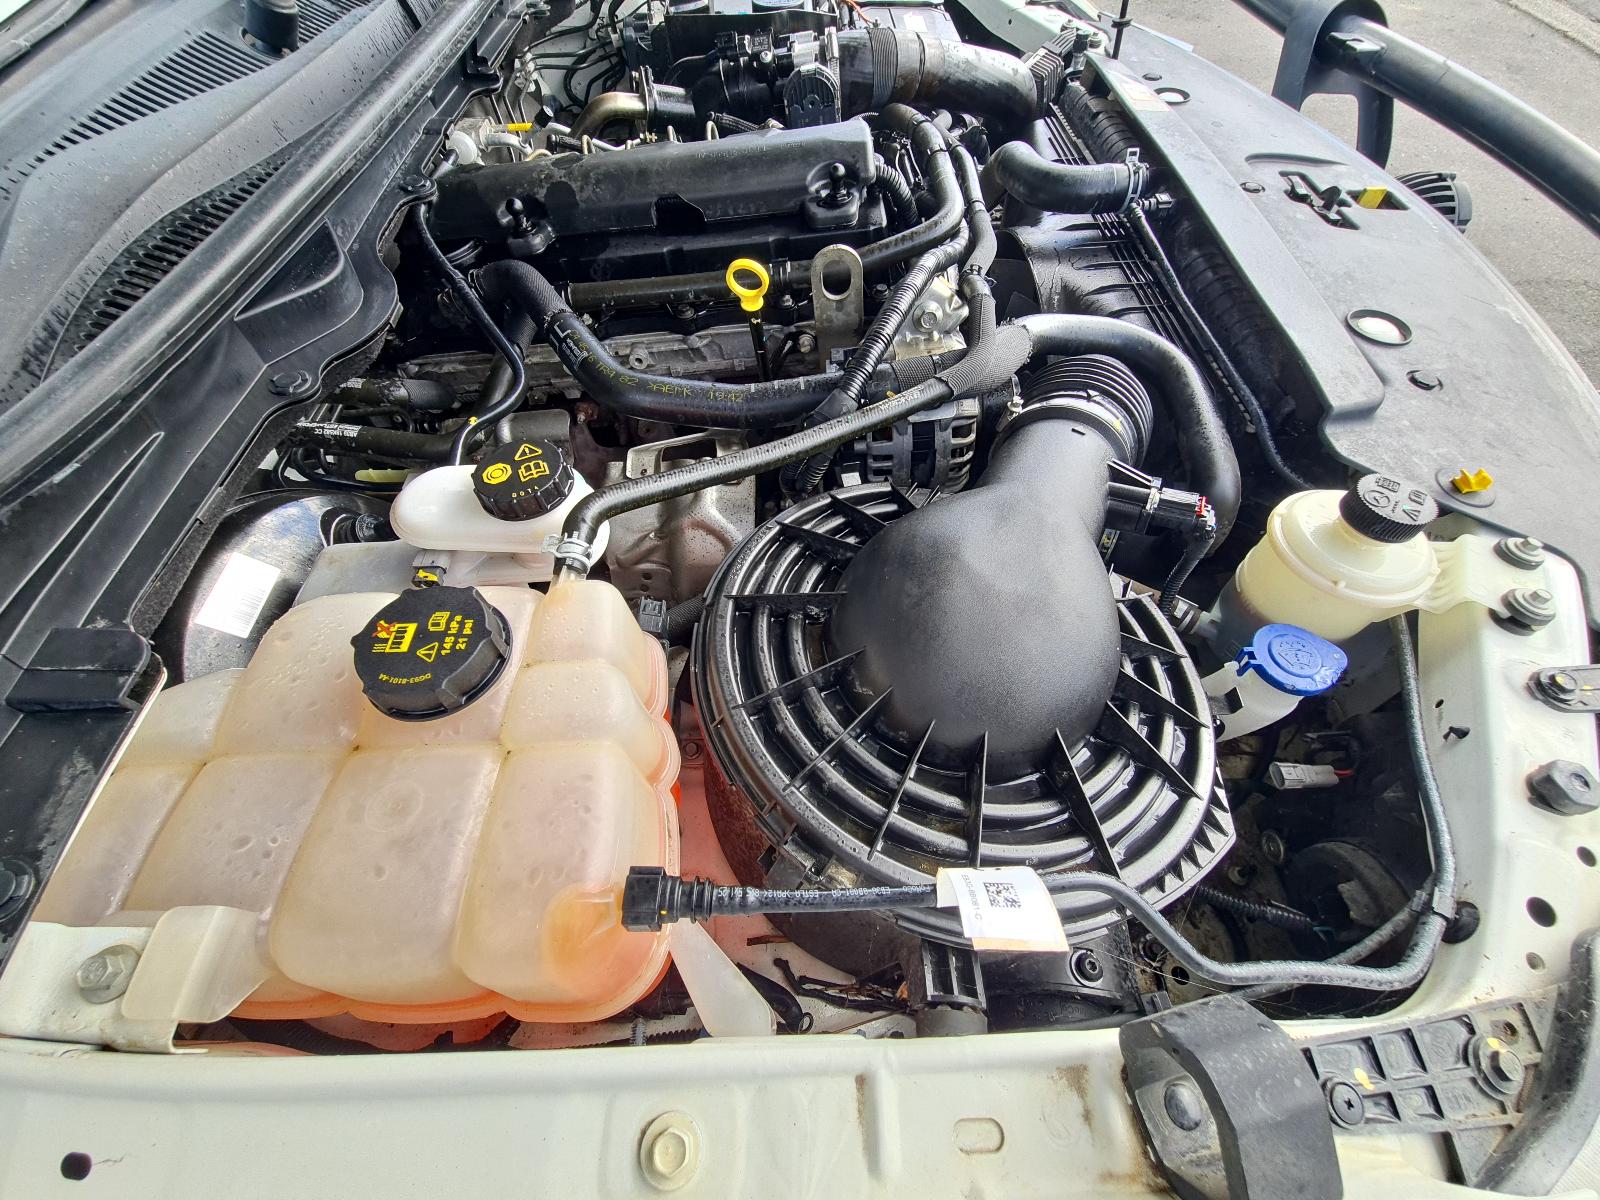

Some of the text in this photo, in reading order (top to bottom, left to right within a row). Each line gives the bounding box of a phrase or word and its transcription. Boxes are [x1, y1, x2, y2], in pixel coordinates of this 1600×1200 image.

[440, 614, 463, 656] 145 kPa
[455, 619, 474, 650] 21 psi
